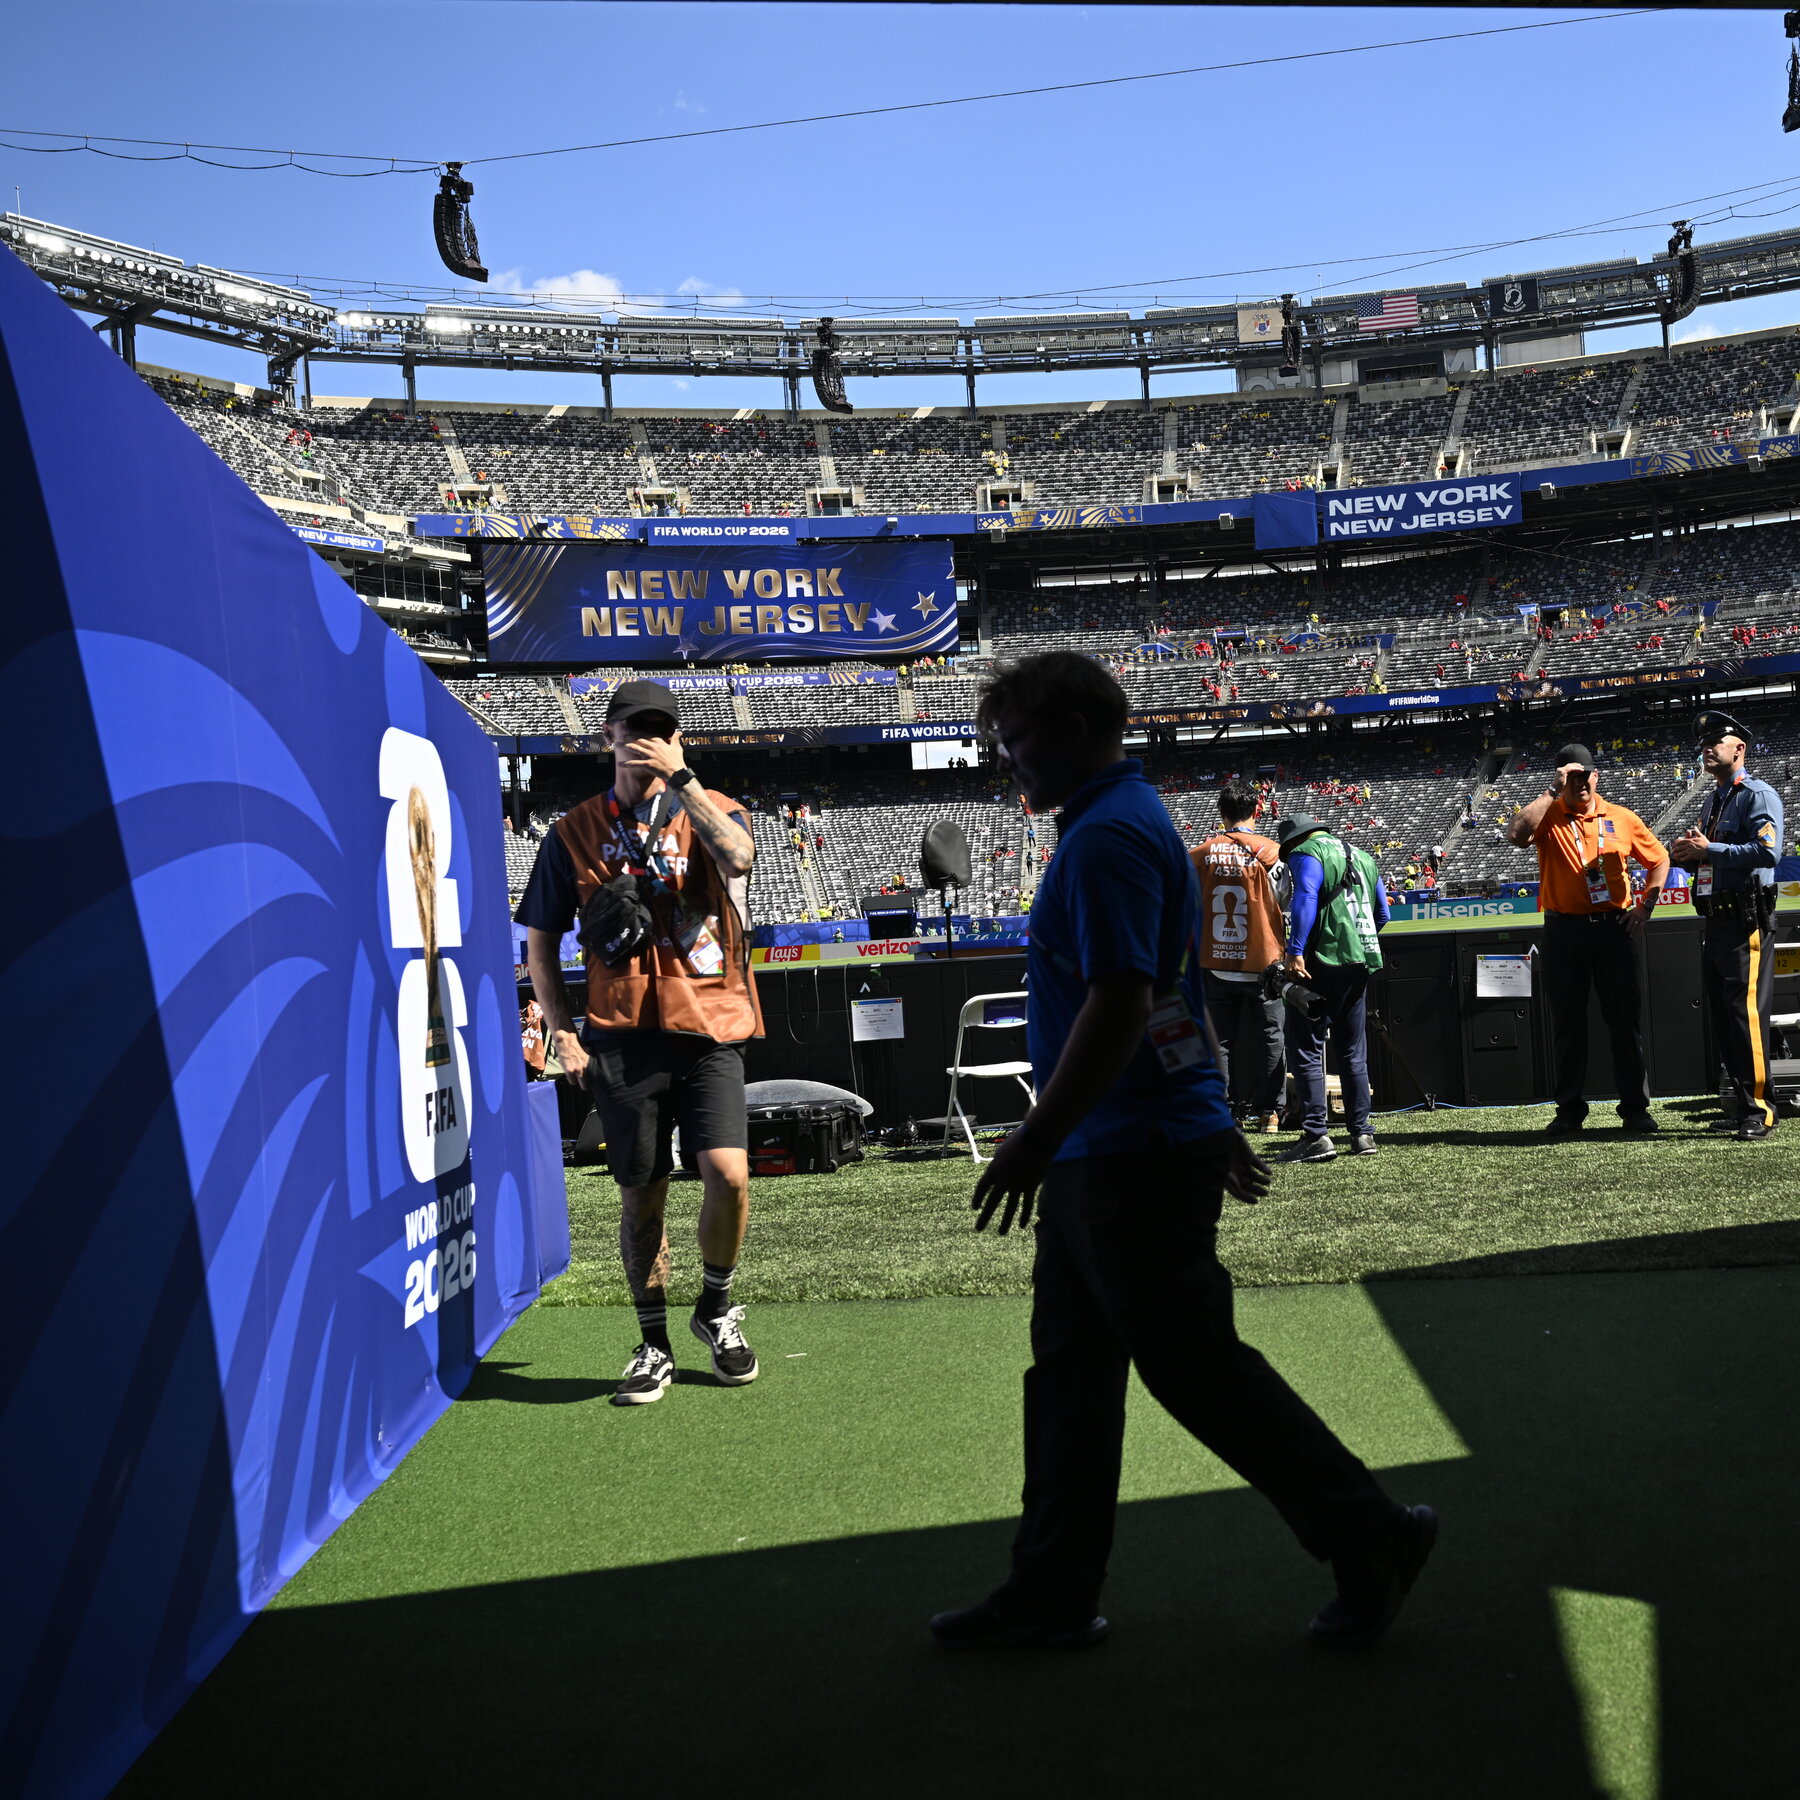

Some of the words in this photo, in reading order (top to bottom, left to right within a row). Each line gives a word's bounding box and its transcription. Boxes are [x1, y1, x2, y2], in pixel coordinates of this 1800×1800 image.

[1328, 493, 1407, 516] NEW
[1414, 482, 1513, 508] YORK
[1329, 517, 1394, 536] NEW
[1401, 505, 1514, 530] JERSEY
[298, 529, 327, 541] NEW
[329, 535, 377, 549] JERSEY
[654, 526, 679, 537] FIFA
[680, 526, 723, 536] WORLD
[724, 526, 747, 536] CUP
[748, 526, 790, 536] 2026
[606, 570, 709, 600] NEW
[722, 567, 845, 599] YORK
[581, 606, 684, 637] NEW
[698, 602, 871, 636] JERSEY
[668, 678, 696, 689] FIFA
[739, 676, 763, 687] CUP
[763, 675, 804, 686] 2026
[1580, 679, 1605, 689] NEW
[1606, 676, 1636, 687] YORK
[1639, 673, 1662, 683] NEW
[1388, 695, 1440, 706] #FIFAWorldCup
[1127, 715, 1151, 725] NEW
[1151, 712, 1180, 724] YORK
[1183, 711, 1206, 721] NEW
[714, 734, 740, 745] NEW
[882, 728, 910, 739] FIFA
[911, 725, 959, 738] WORLD
[960, 724, 977, 735] CU
[1411, 900, 1514, 920] Hisense
[941, 925, 966, 936] FFA
[1222, 930, 1238, 938] FIFA
[1212, 951, 1247, 960] 2026
[425, 1086, 457, 1137] FIFA
[405, 1194, 451, 1252] WORLD
[453, 1182, 476, 1225] CUP
[404, 1229, 477, 1329] 2026
